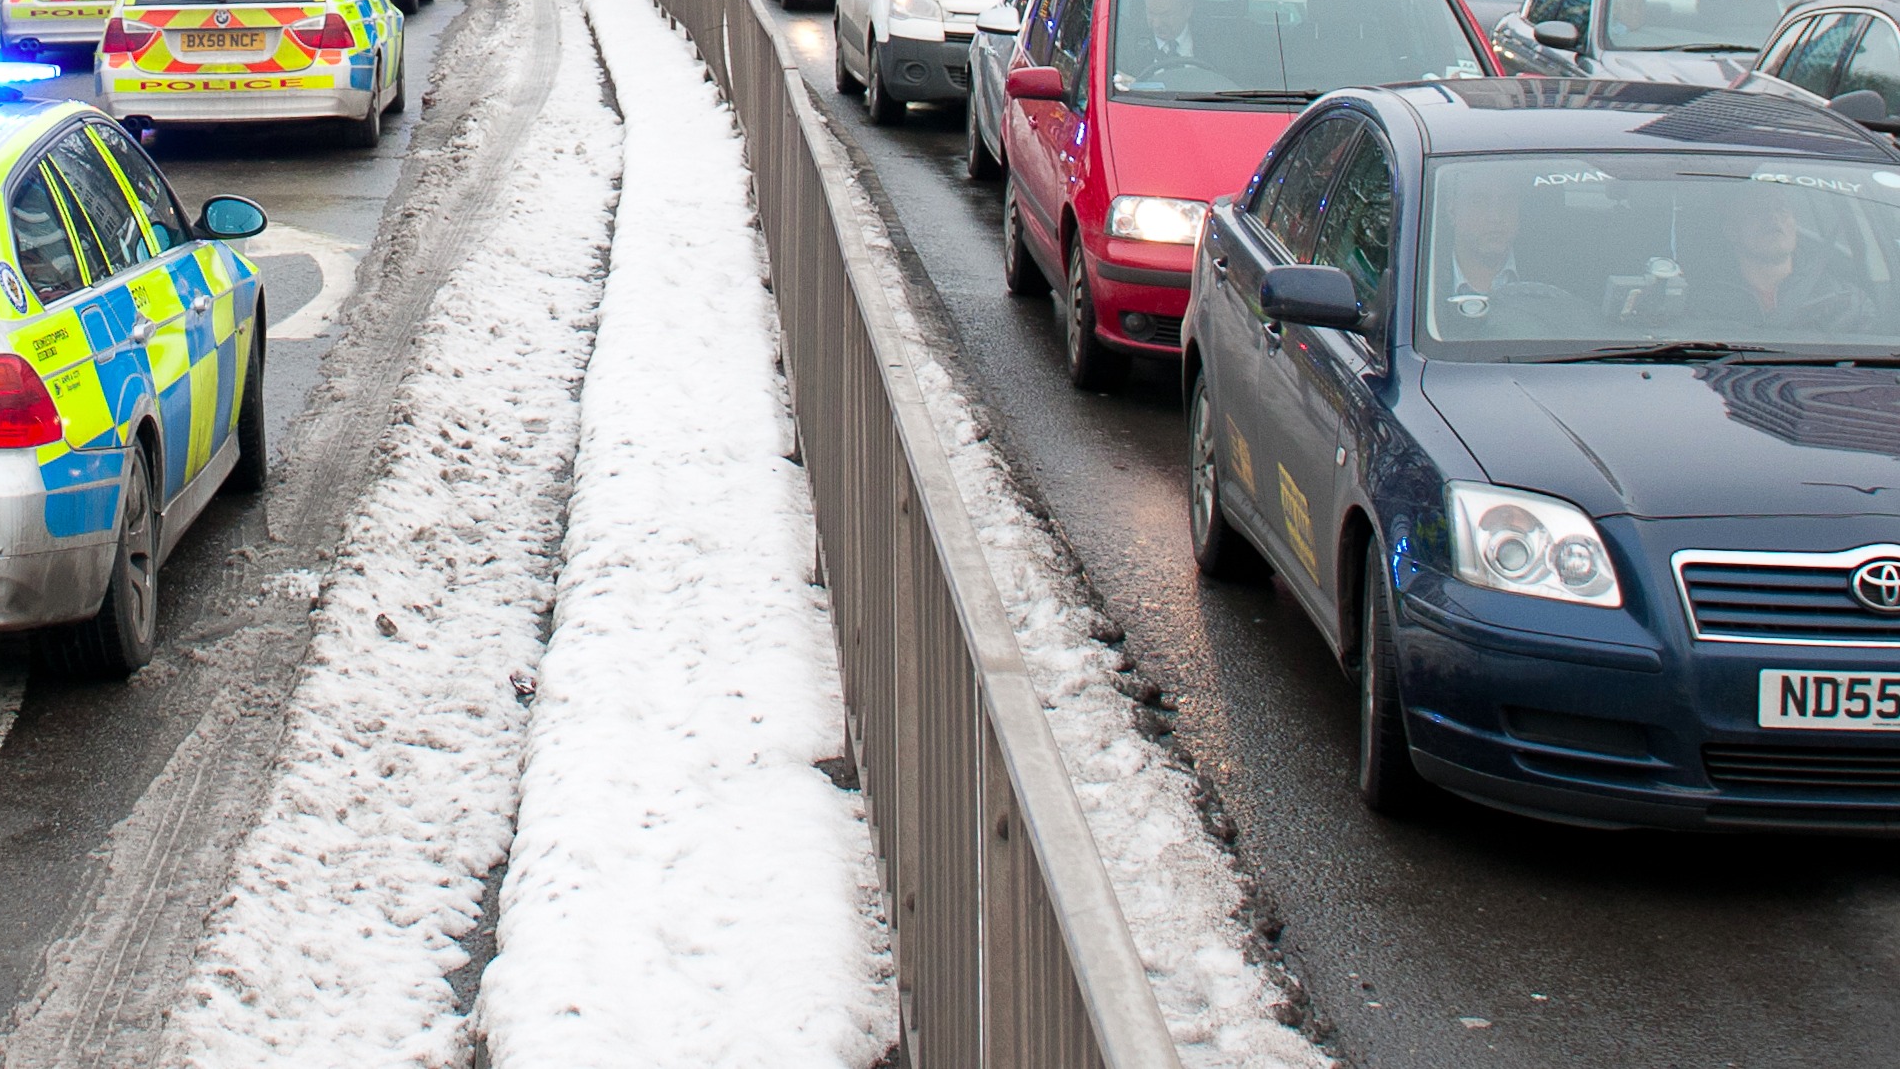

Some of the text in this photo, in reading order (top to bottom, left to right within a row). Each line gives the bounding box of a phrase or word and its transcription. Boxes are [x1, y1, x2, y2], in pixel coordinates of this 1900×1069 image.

[30, 8, 111, 17] POLI
[186, 33, 259, 48] BX58 NCF
[140, 78, 303, 90] POLICE
[1795, 175, 1861, 193] ONLY
[1780, 675, 1900, 719] ND55
